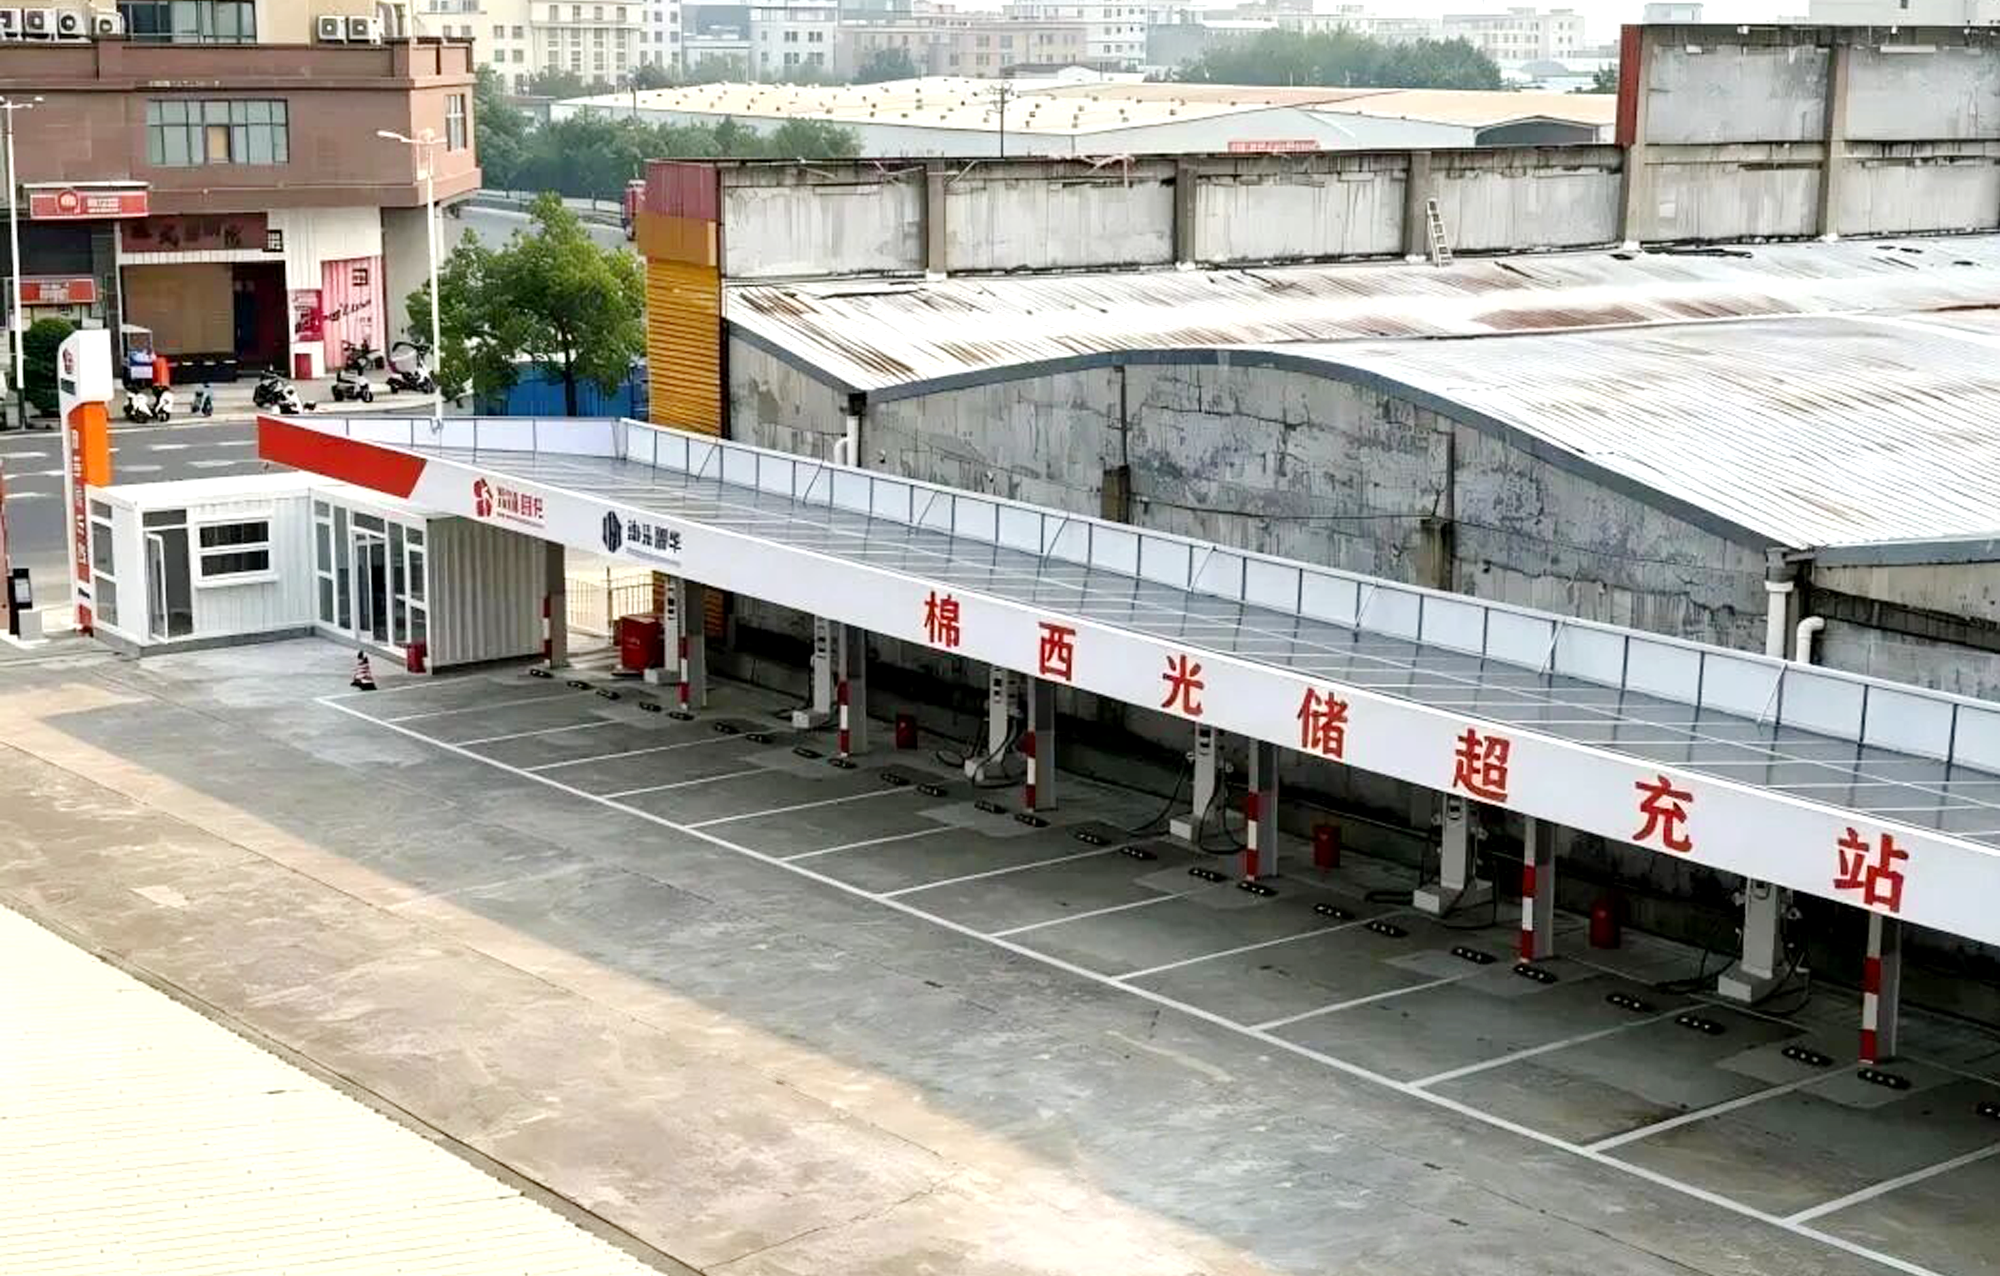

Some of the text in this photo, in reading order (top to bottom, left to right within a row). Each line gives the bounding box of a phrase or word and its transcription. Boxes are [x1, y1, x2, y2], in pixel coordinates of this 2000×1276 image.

[924, 592, 1908, 913] 棉西光储超充站
